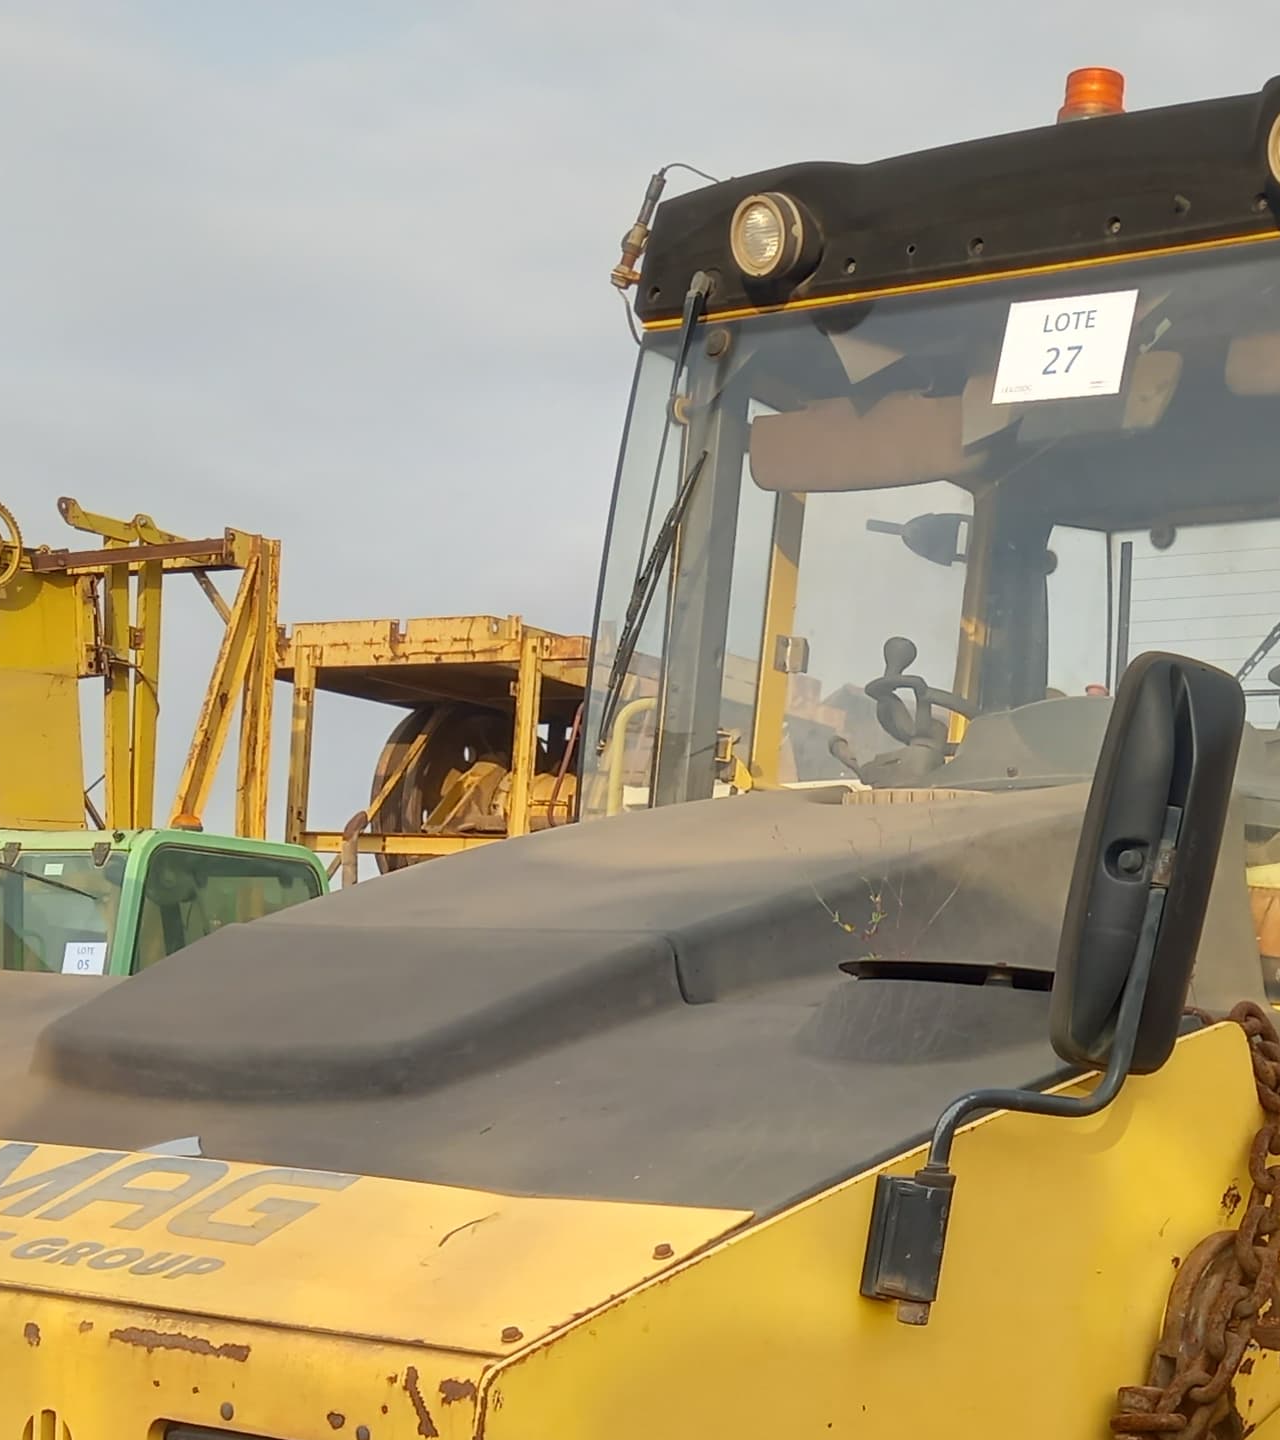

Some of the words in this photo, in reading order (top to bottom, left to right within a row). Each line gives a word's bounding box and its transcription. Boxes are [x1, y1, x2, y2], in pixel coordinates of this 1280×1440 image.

[1042, 309, 1098, 334] LOTE
[1041, 345, 1084, 376] 27
[76, 959, 91, 970] 05
[10, 1235, 226, 1281] GROUP
